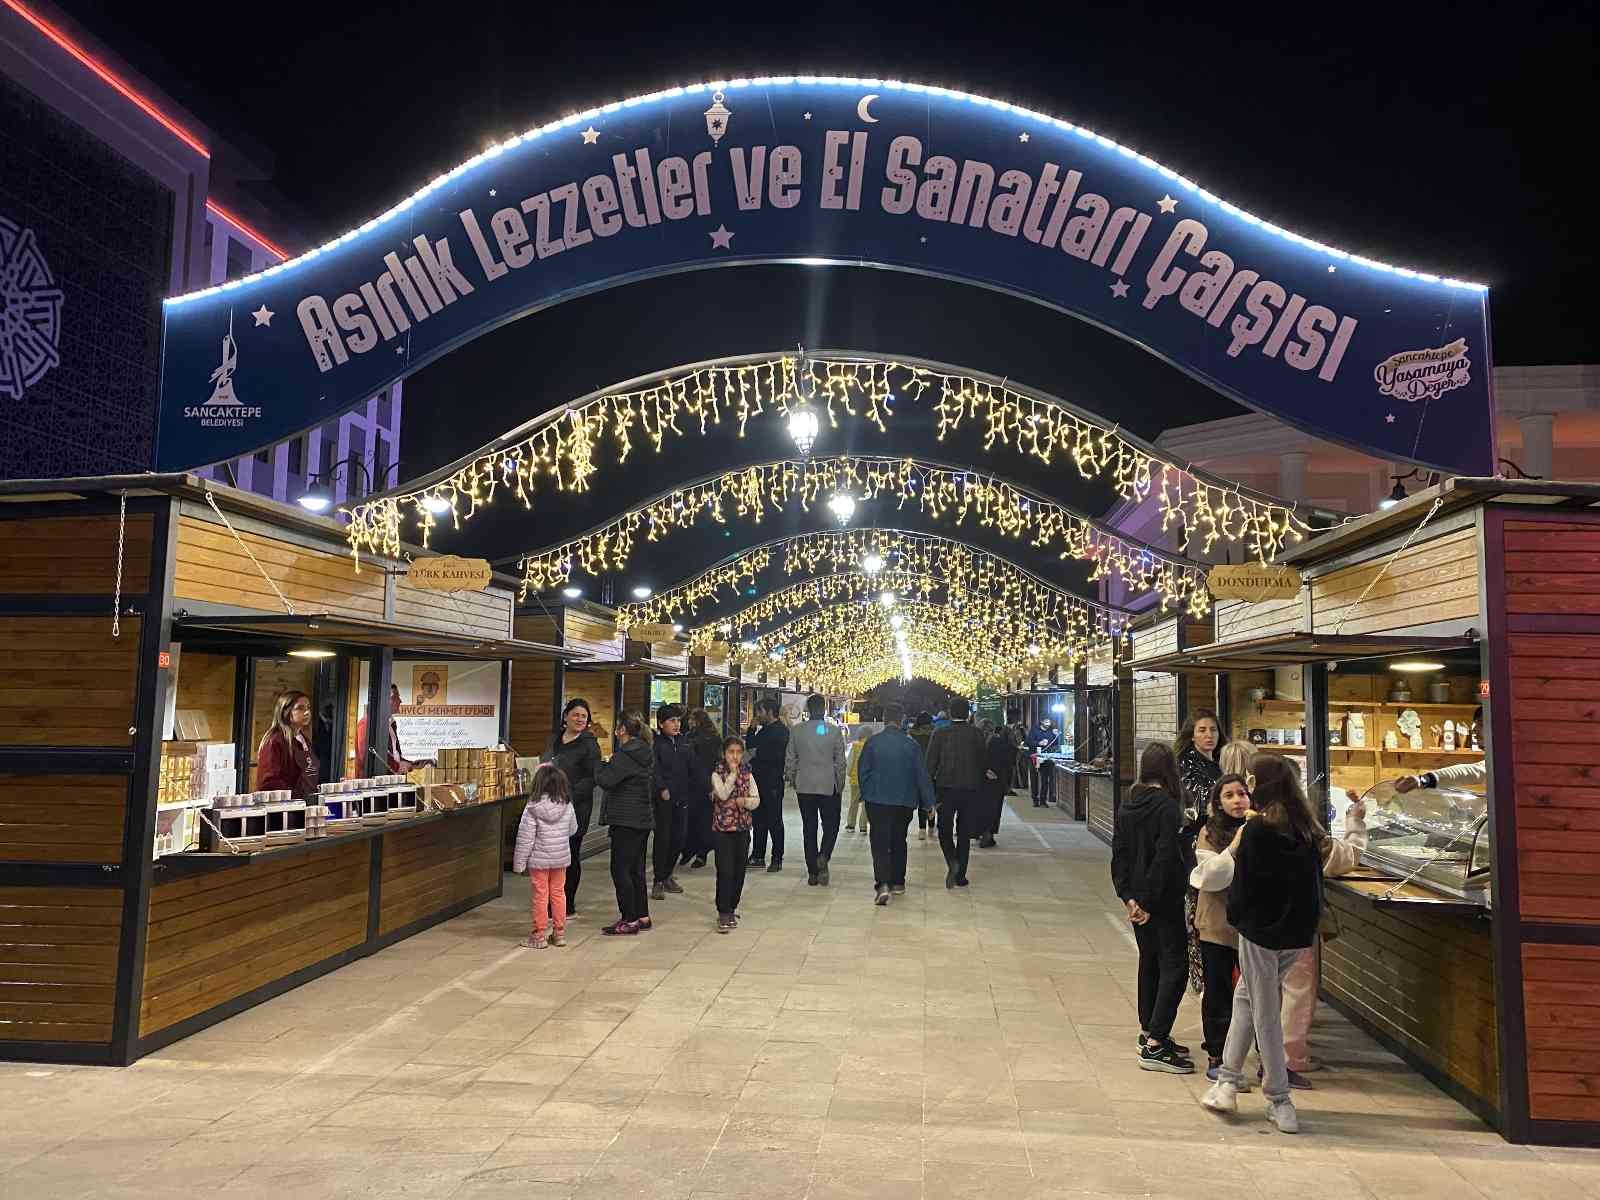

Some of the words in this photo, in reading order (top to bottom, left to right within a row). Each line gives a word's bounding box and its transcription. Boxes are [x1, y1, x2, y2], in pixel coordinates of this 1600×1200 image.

[297, 234, 475, 373] Asırlık
[459, 148, 712, 282] Lezzetler
[729, 145, 802, 210] ve
[820, 130, 868, 210] El
[880, 135, 1152, 276] Sanatları
[1141, 218, 1358, 383] Çarşısı
[183, 406, 263, 418] SANCAKTEPE
[1217, 577, 1292, 588] DONDURMA
[158, 654, 170, 666] 30
